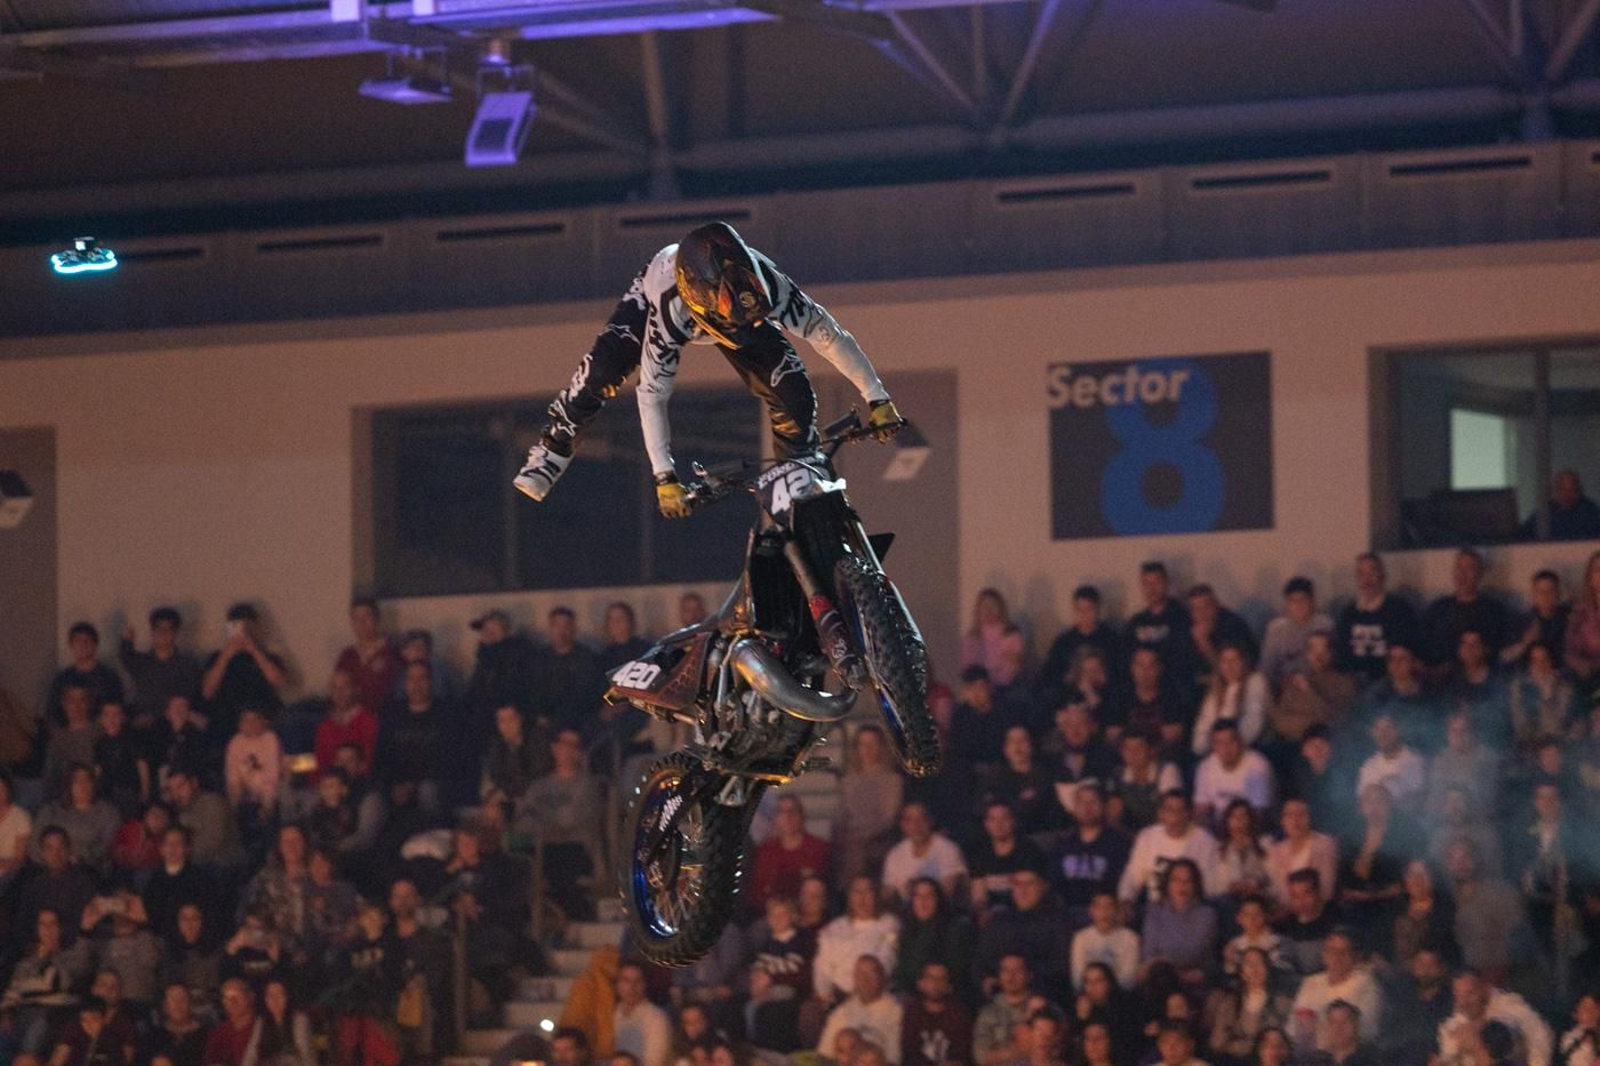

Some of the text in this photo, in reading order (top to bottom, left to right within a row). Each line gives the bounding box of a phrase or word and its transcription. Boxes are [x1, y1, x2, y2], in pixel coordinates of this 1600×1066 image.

[1049, 365, 1190, 408] Sector
[1101, 357, 1227, 537] 8
[611, 660, 662, 690] 420
